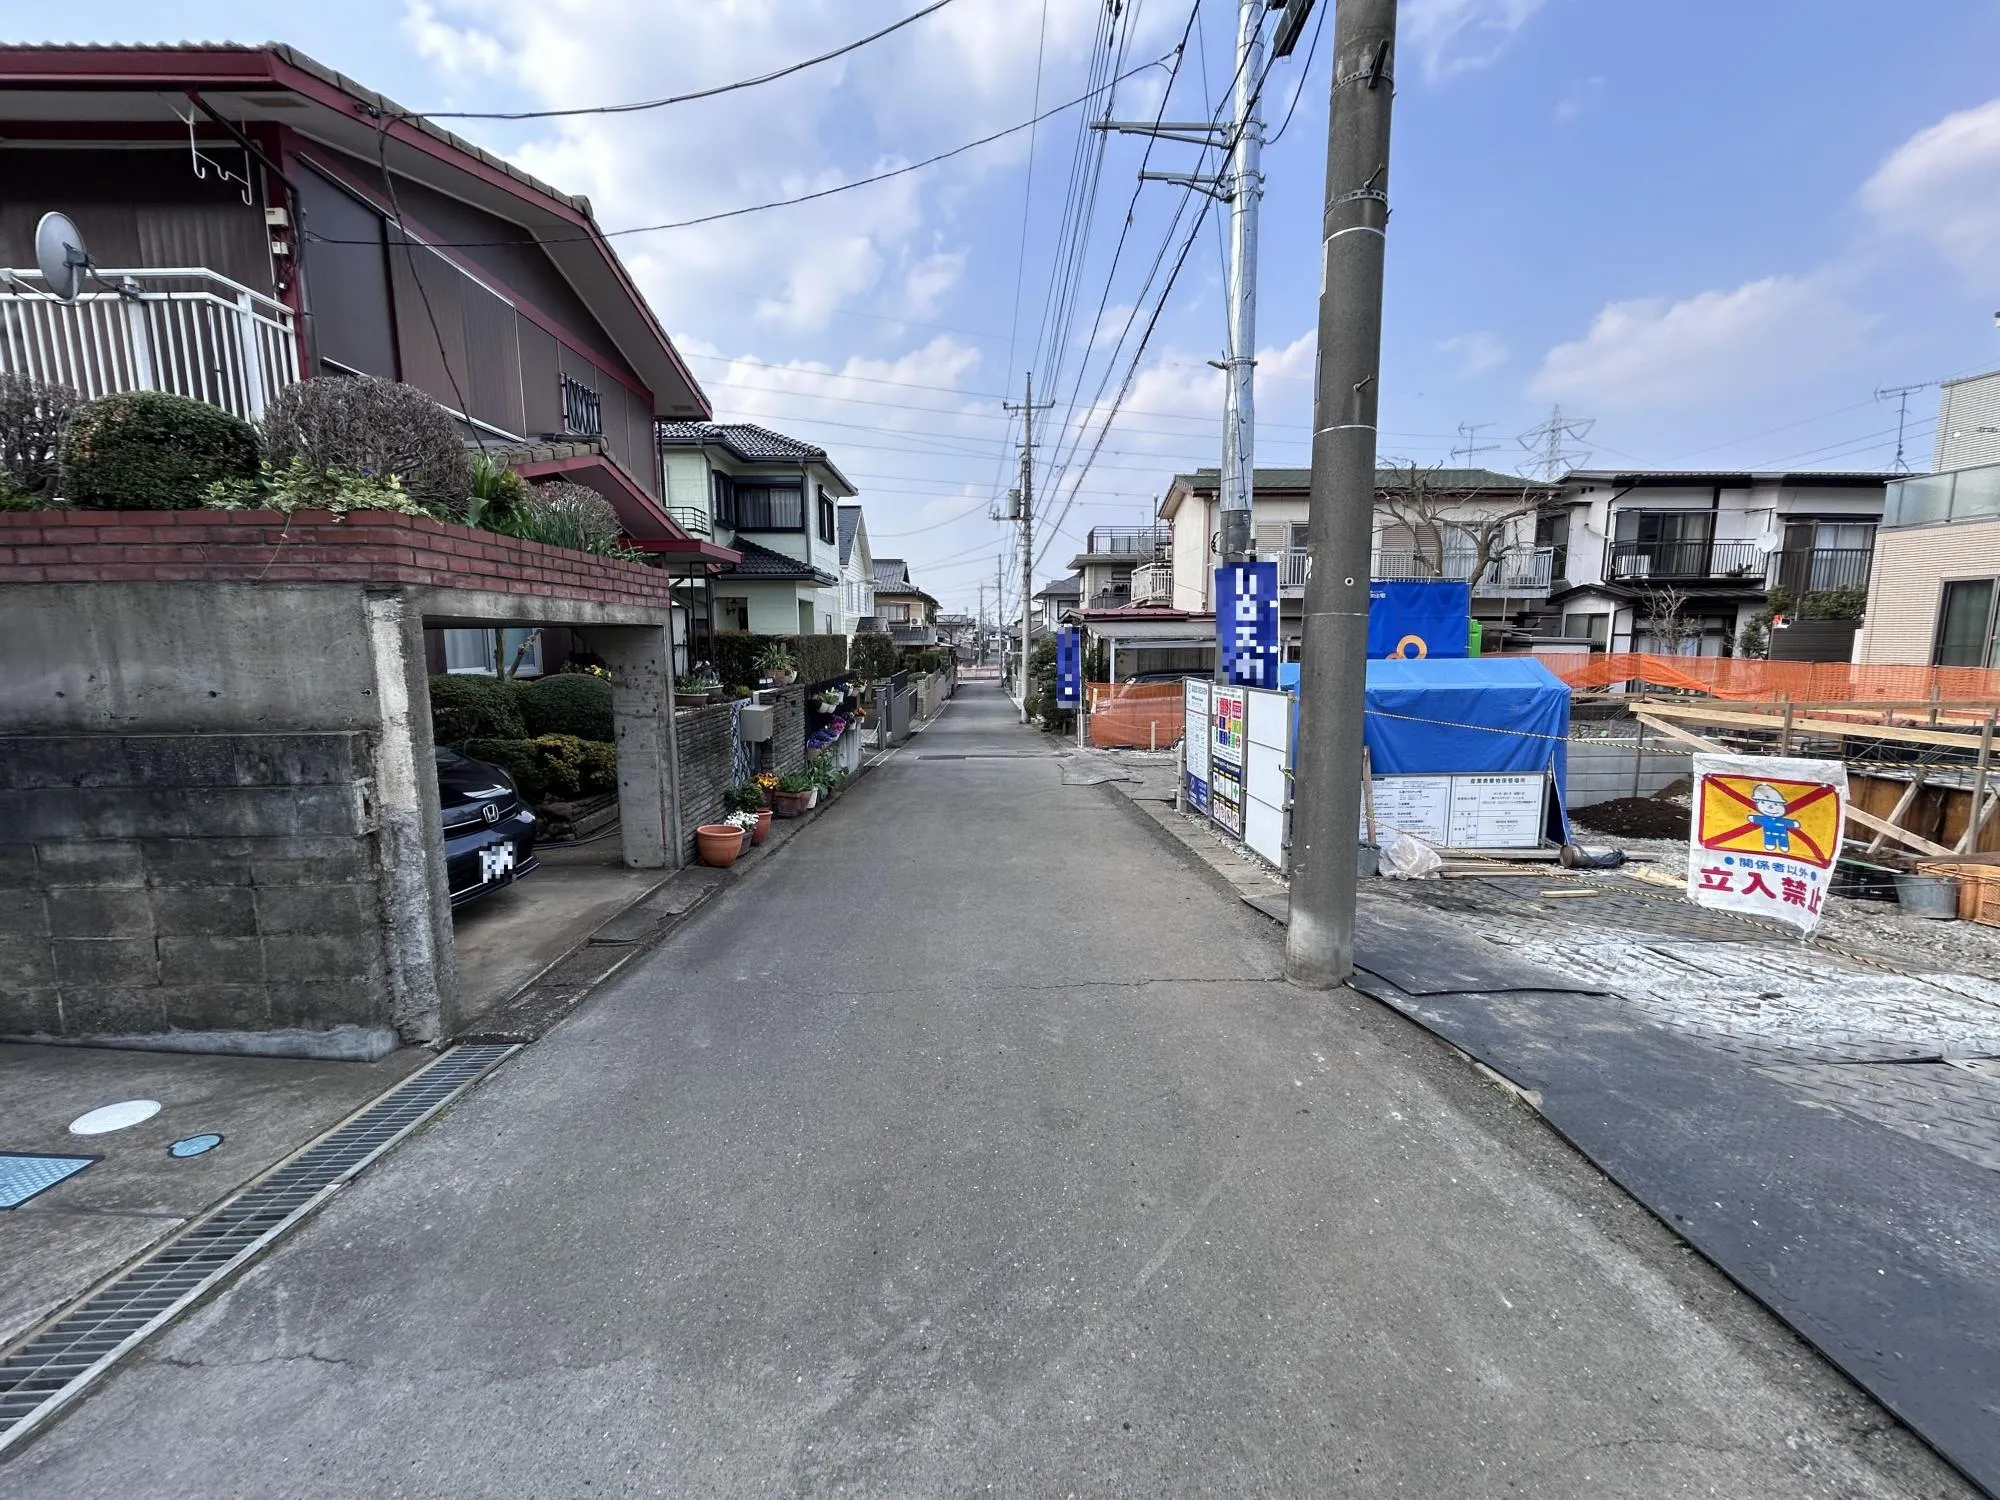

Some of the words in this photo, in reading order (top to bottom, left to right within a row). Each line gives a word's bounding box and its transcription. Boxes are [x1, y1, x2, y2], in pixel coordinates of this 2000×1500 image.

[1739, 857, 1809, 879] 関係者以外
[1698, 866, 1822, 915] 立入禁止
